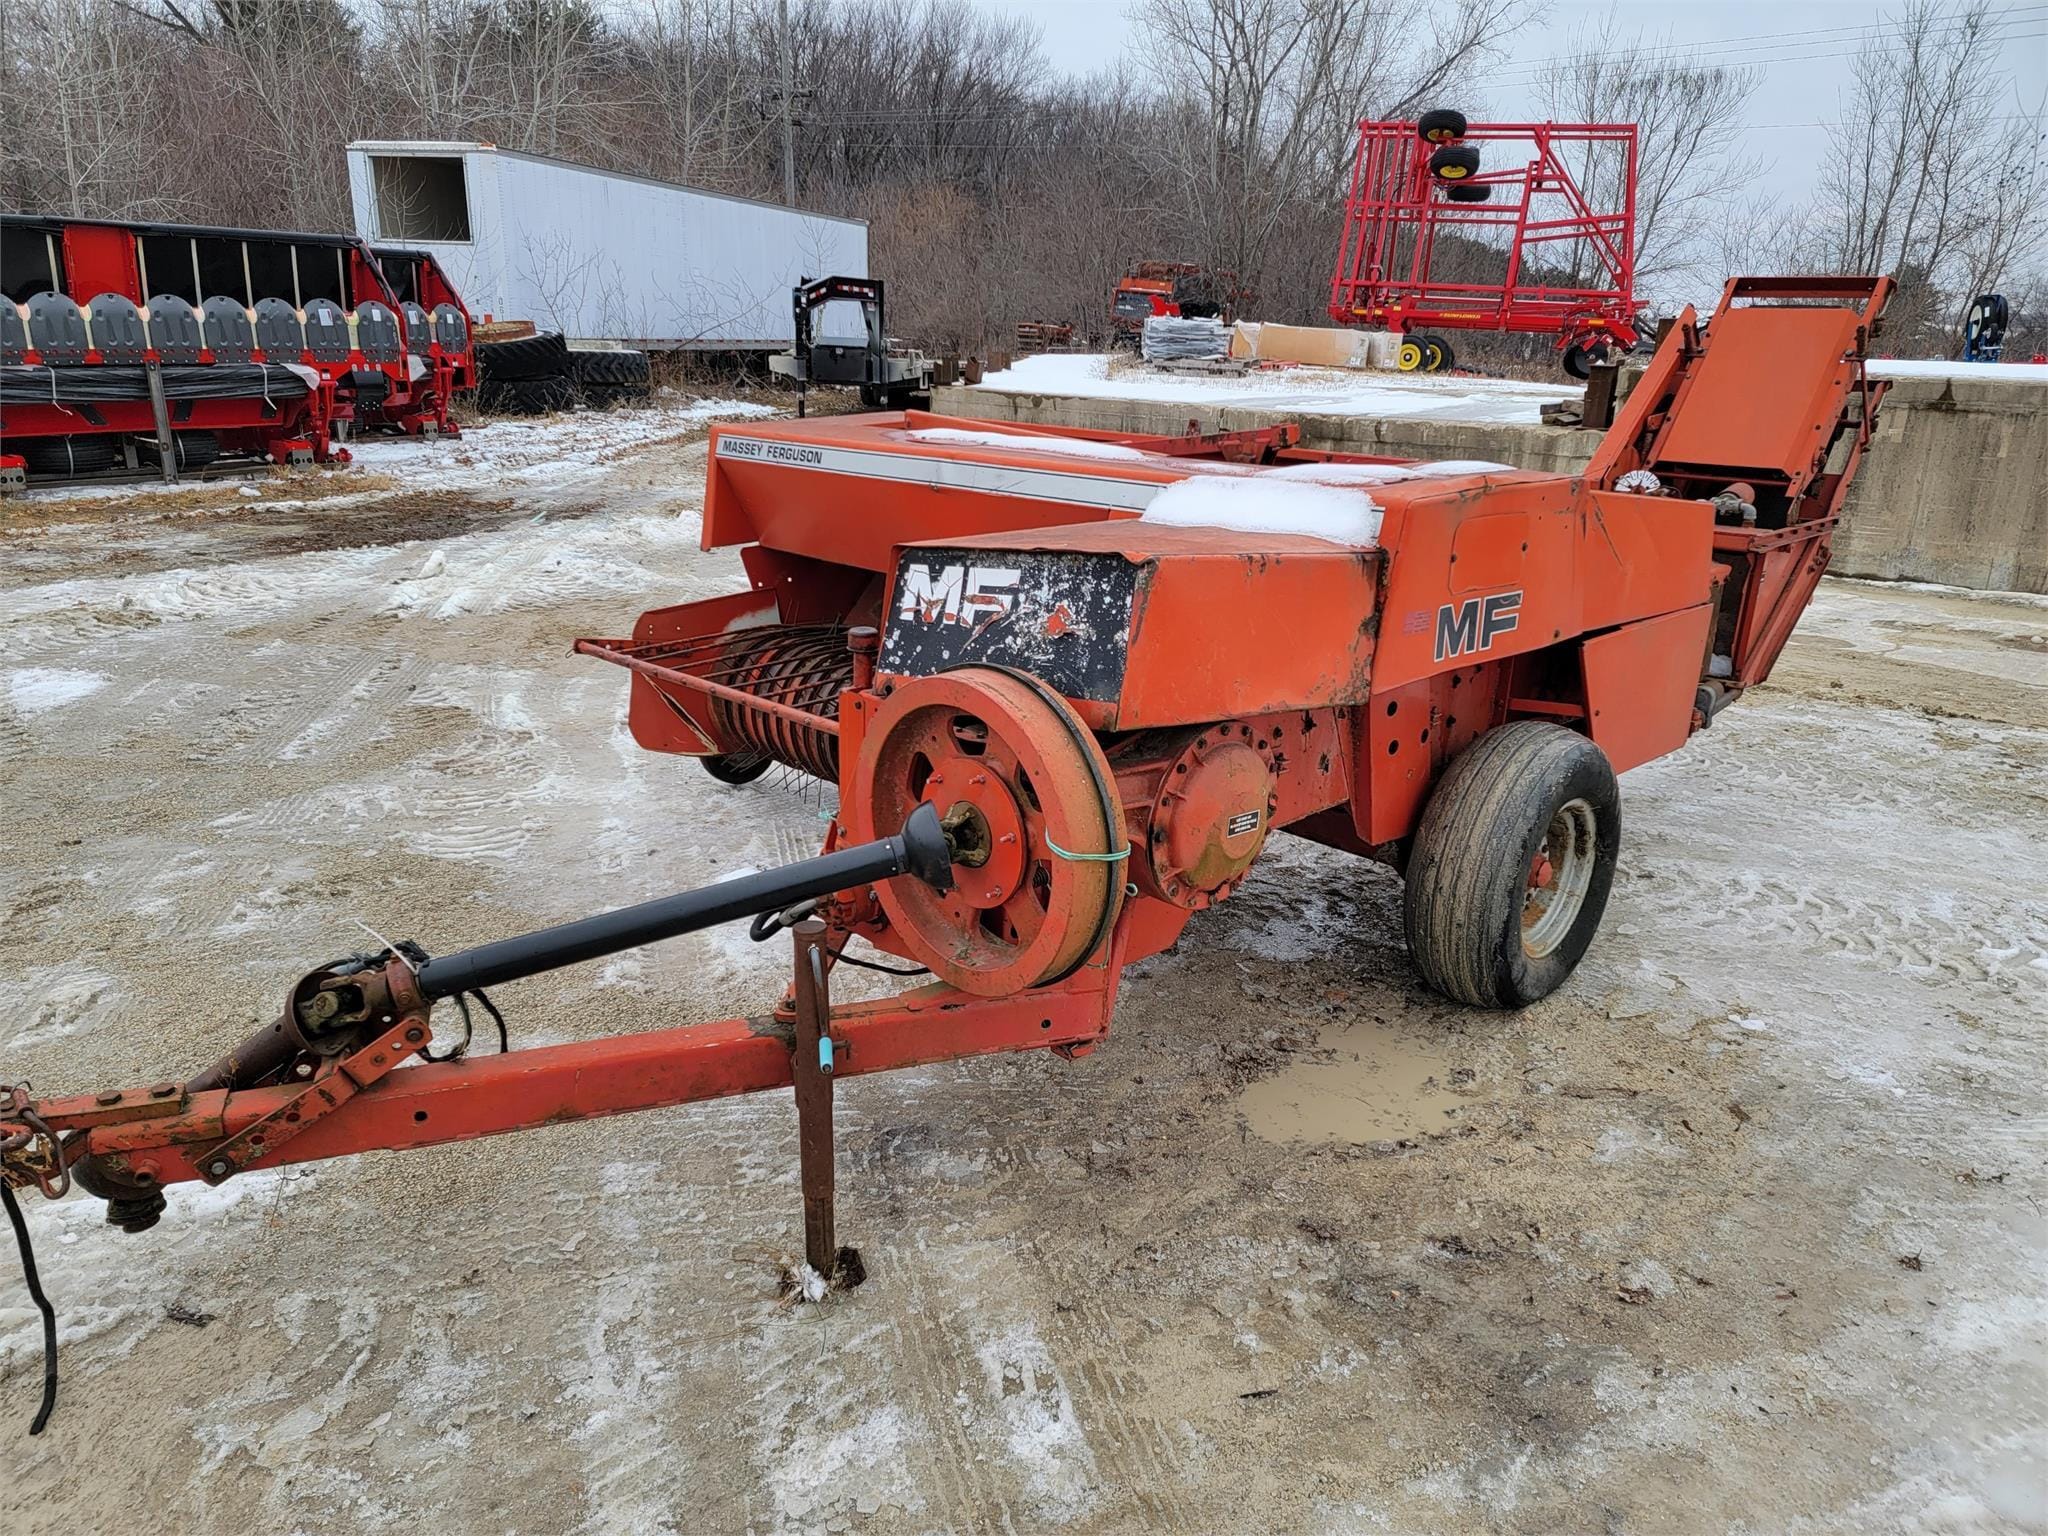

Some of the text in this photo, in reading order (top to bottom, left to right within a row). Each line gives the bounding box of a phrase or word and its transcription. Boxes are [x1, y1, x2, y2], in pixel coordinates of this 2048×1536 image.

[722, 440, 823, 464] MASSEY FERGUSON
[899, 562, 1022, 628] MF
[1434, 590, 1523, 662] MF
